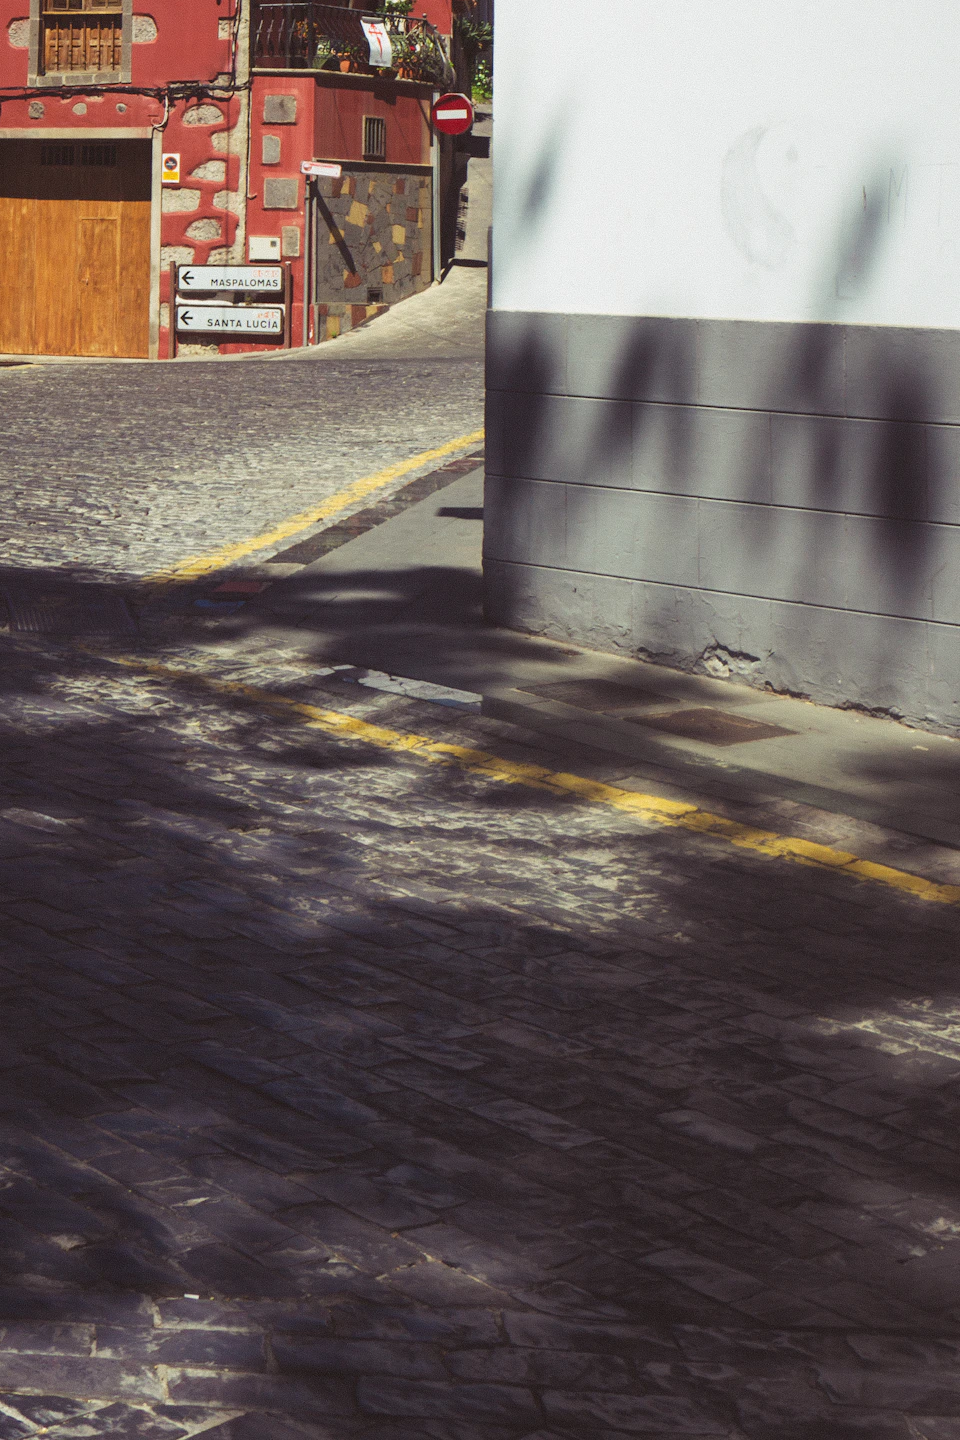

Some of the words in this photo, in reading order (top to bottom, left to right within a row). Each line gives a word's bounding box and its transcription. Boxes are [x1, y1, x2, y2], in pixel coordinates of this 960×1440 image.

[210, 279, 279, 287] MASPALOMAS
[207, 319, 243, 327] SANTA
[246, 318, 279, 329] LUCÍA
